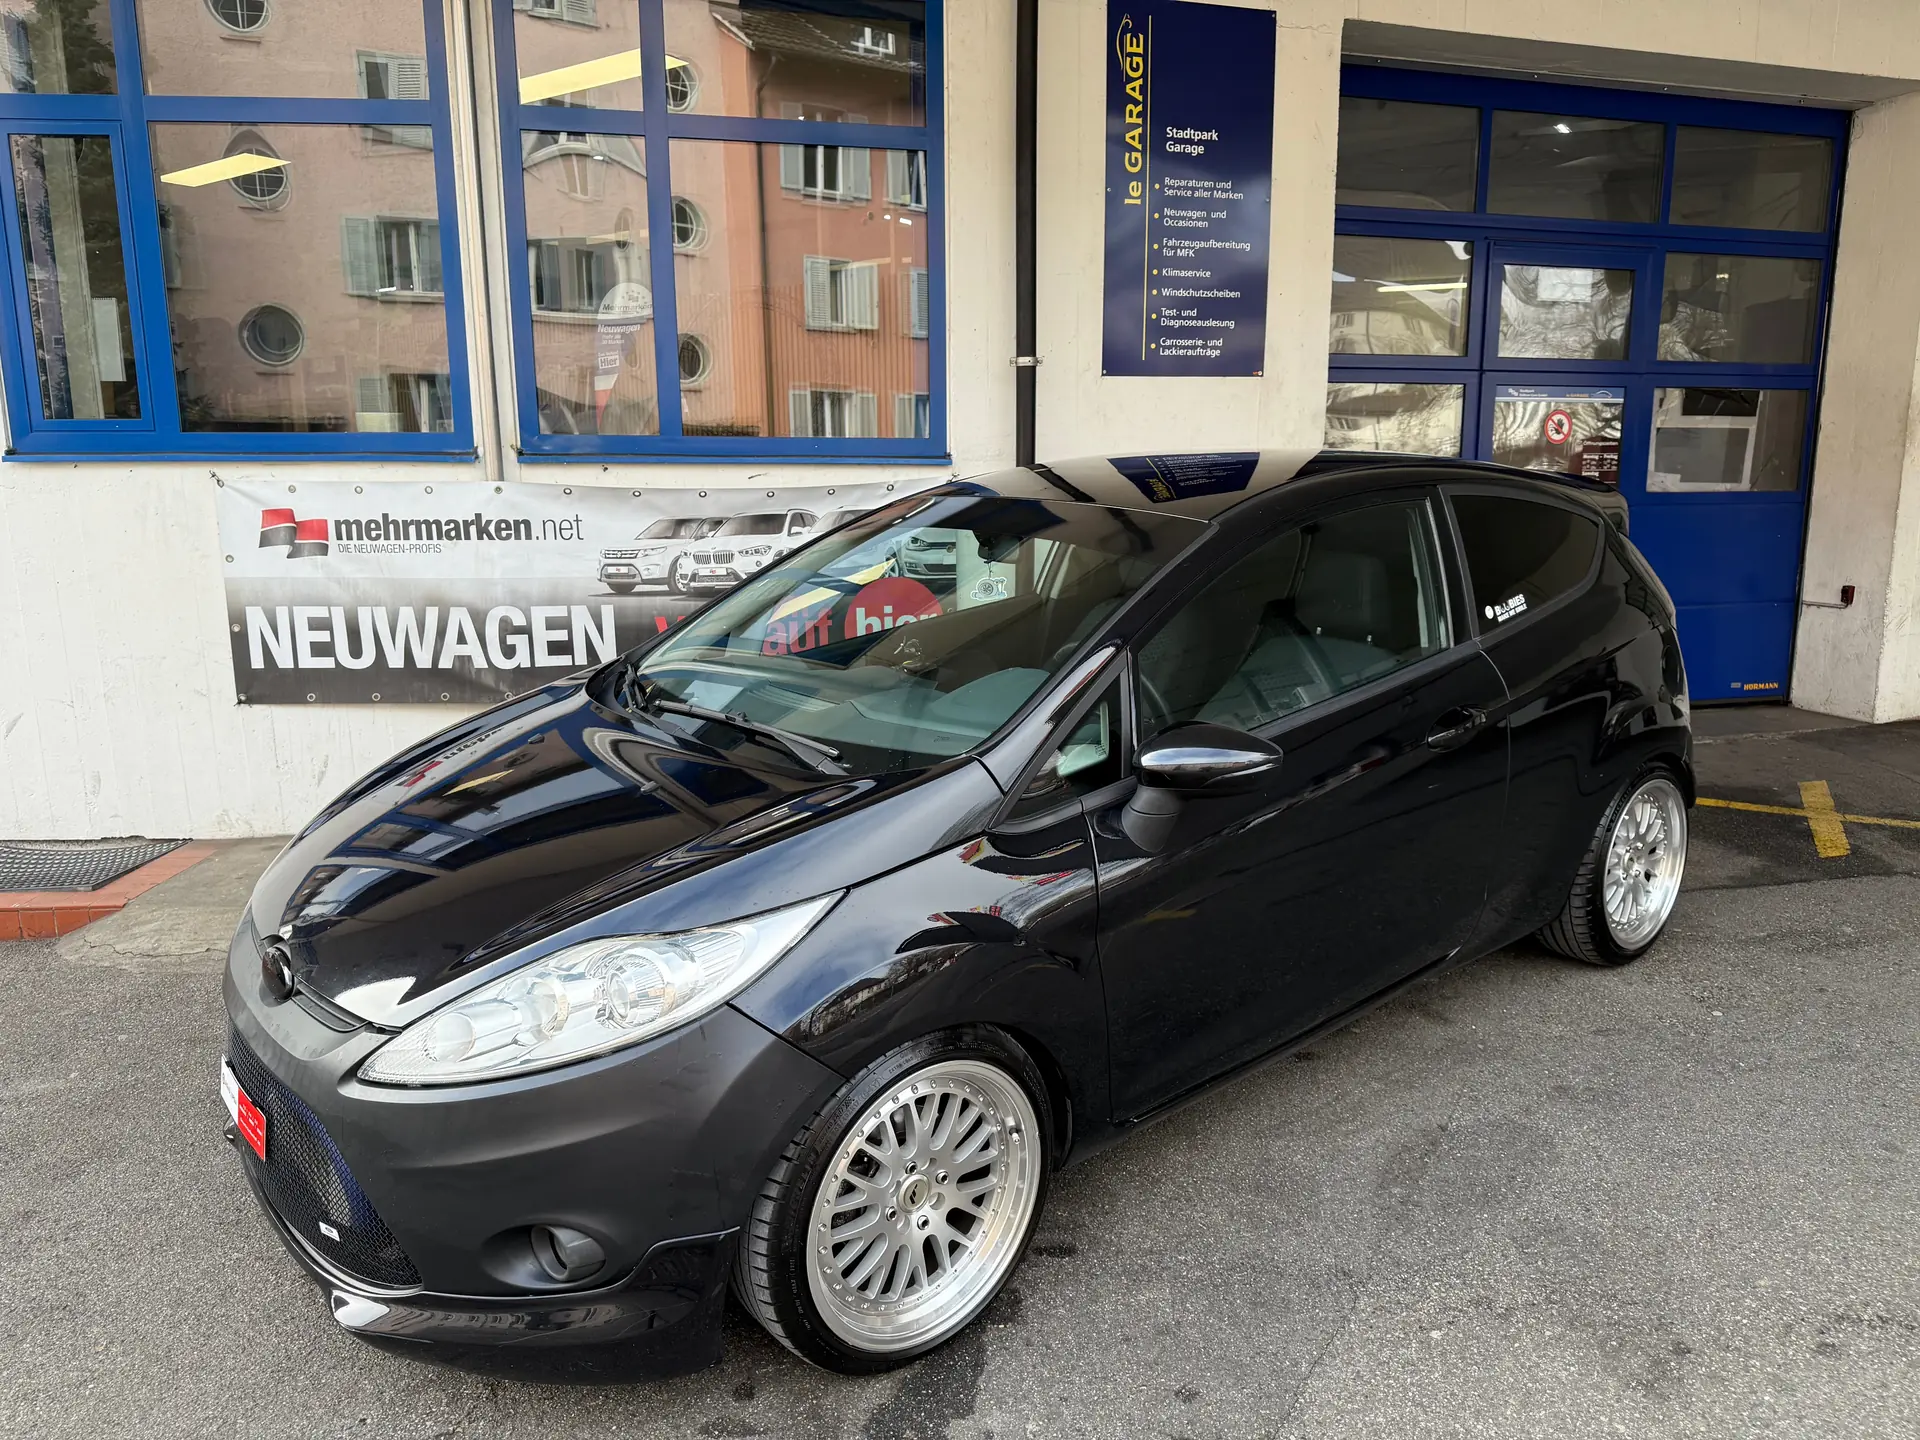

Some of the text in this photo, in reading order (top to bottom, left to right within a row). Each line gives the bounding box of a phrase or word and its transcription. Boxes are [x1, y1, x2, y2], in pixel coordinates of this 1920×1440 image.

[1124, 33, 1144, 205] le GARAGE
[1166, 126, 1219, 141] Stadtpark
[1166, 141, 1204, 156] Garage
[1164, 177, 1232, 189] Reparaturen und
[1164, 187, 1244, 200] Service aller Marken
[1163, 207, 1227, 219] Neuwagen und
[1163, 218, 1208, 228] Occasionen
[1163, 237, 1251, 252] Fahrzeugaufbereitung
[1162, 247, 1195, 257] für MFK
[1162, 268, 1211, 278] Klimaservice
[1161, 288, 1241, 298] Windschutzscheiben
[1160, 307, 1197, 317] Test- und
[597, 323, 641, 334] Neuwagen
[1160, 317, 1235, 329] Diagnoseauslesung
[1160, 337, 1223, 347] Carrosserie- und
[1159, 347, 1221, 358] Lackieraufträge
[600, 357, 618, 367] Hier
[334, 512, 584, 542] mehrmarken.net
[338, 543, 442, 554] DIE NEUWAGEN-PROFIS
[245, 604, 618, 670] NEUWAGEN
